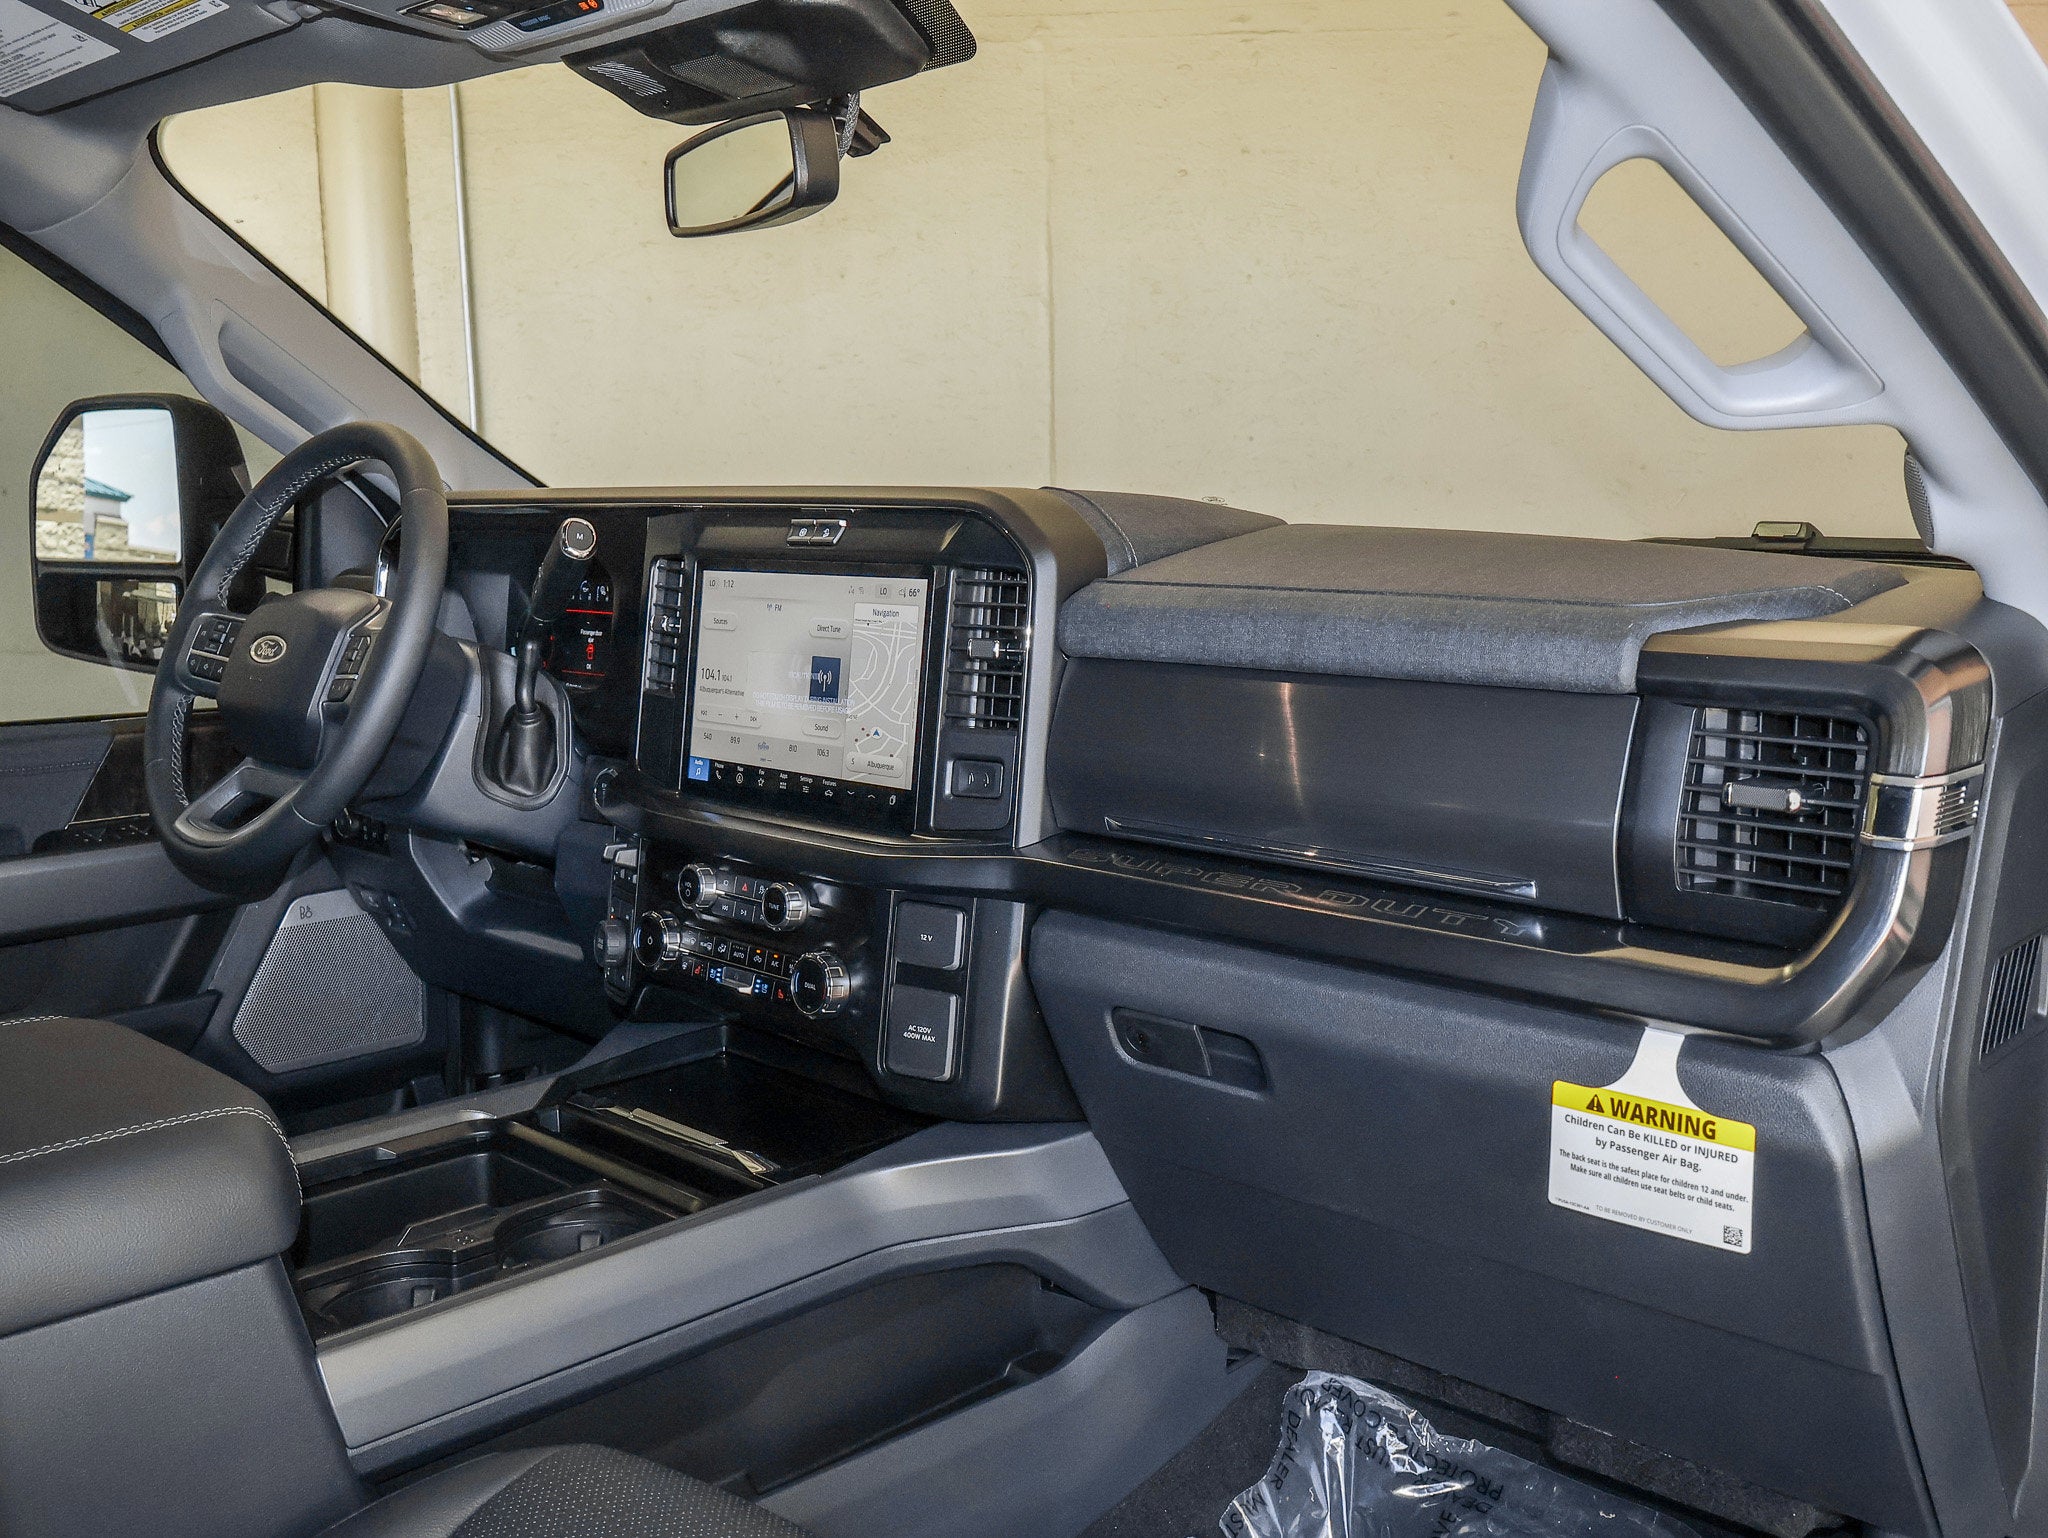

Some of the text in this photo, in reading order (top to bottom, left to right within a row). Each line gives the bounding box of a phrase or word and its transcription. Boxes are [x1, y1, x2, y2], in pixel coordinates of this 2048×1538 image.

[723, 580, 735, 588] 1:12
[880, 587, 888, 595] LO
[908, 588, 921, 598] 66°
[774, 603, 782, 612] FM
[872, 608, 900, 618] Navigation
[816, 624, 842, 634] Direct Tune
[701, 667, 720, 681] 104.1
[814, 723, 829, 732] Sound
[703, 732, 712, 741] 540
[788, 744, 798, 753] 810
[816, 748, 830, 758] 106.3
[867, 760, 895, 772] Albuquerque
[768, 902, 780, 911] TUNE
[1317, 888, 1547, 939] DUTY
[733, 950, 744, 959] AUTO
[771, 960, 780, 968] A/C
[804, 981, 816, 991] DUAL
[908, 1024, 932, 1034] AC 120V
[902, 1032, 936, 1043] 400W MAX
[1610, 1097, 1716, 1141] WARNING
[1564, 1114, 1739, 1164] Children Can Be KILLED or INJURED
[1595, 1136, 1702, 1173] by Passenger Air Bag.
[1560, 1148, 1749, 1203] The back seat is the safest place for children 12 and under.
[1570, 1163, 1588, 1174] Make
[1588, 1168, 1602, 1178] sure
[1604, 1173, 1612, 1181] all
[1613, 1175, 1639, 1188] children
[1640, 1183, 1652, 1192] use
[1654, 1185, 1668, 1196] seat
[1669, 1188, 1686, 1200] belts
[1696, 1196, 1712, 1206] child
[1714, 1201, 1735, 1212] seats.
[1596, 1204, 1604, 1212] TO
[1612, 1209, 1638, 1220] REMOVED
[1646, 1218, 1676, 1230] CUSTOMER
[1677, 1226, 1692, 1234] ONLY
